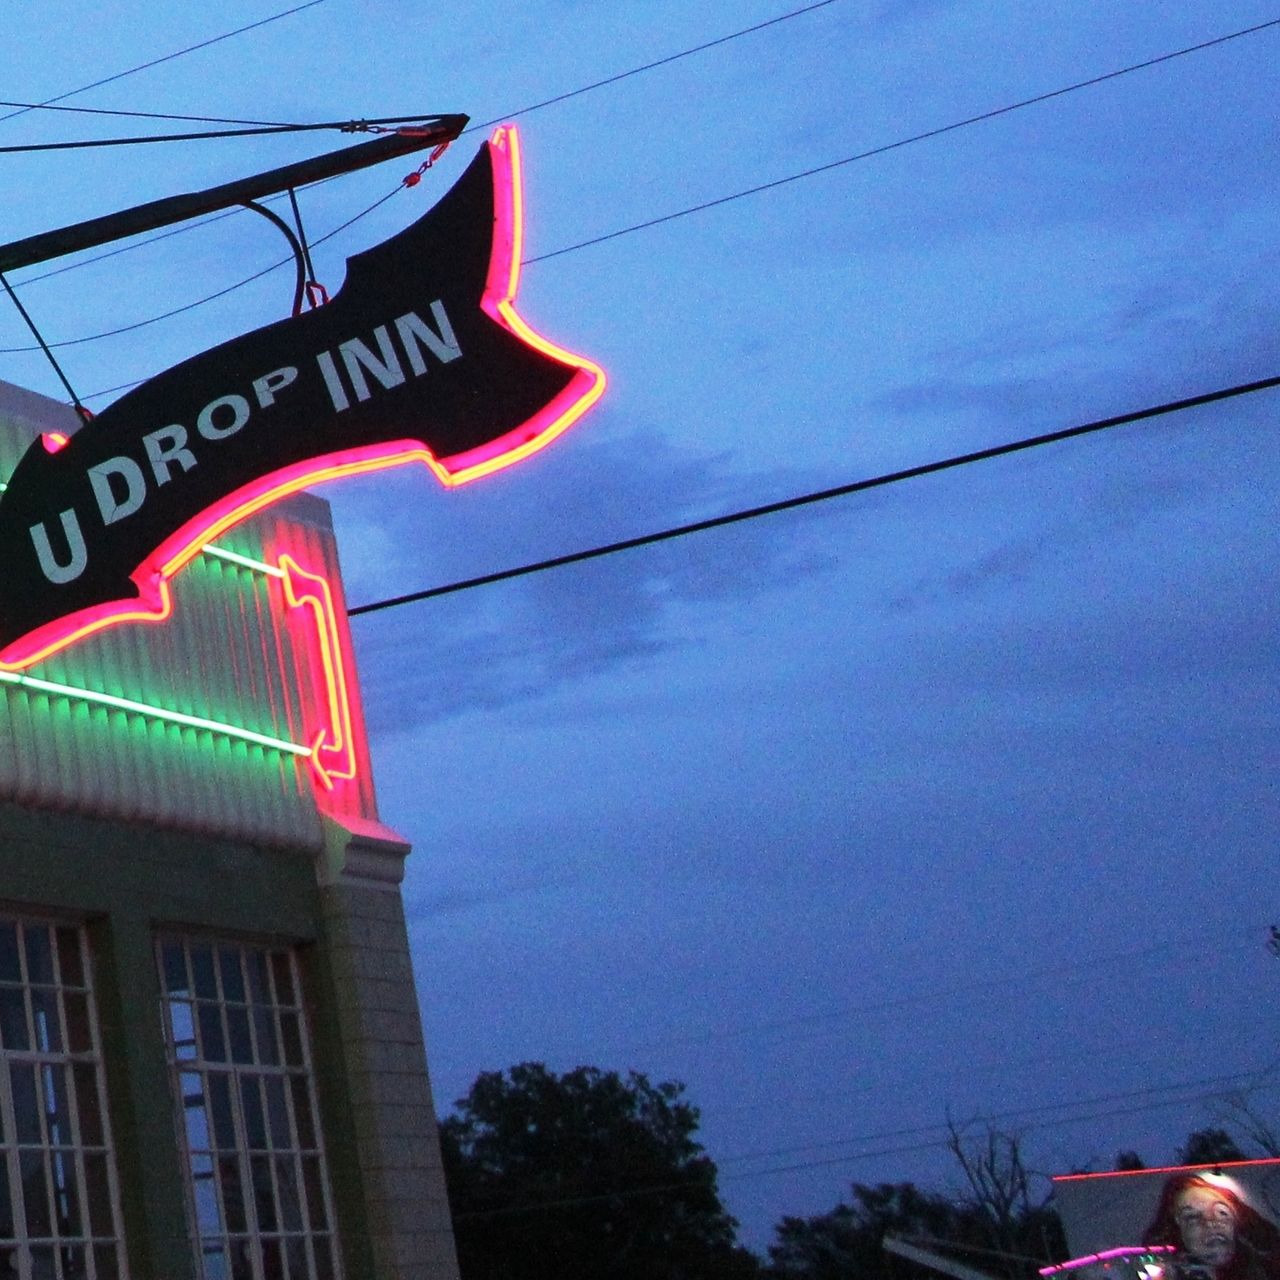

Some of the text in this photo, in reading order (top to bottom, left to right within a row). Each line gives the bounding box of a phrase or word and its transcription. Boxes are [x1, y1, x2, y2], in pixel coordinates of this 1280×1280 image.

[29, 299, 464, 585] U DROP INN
